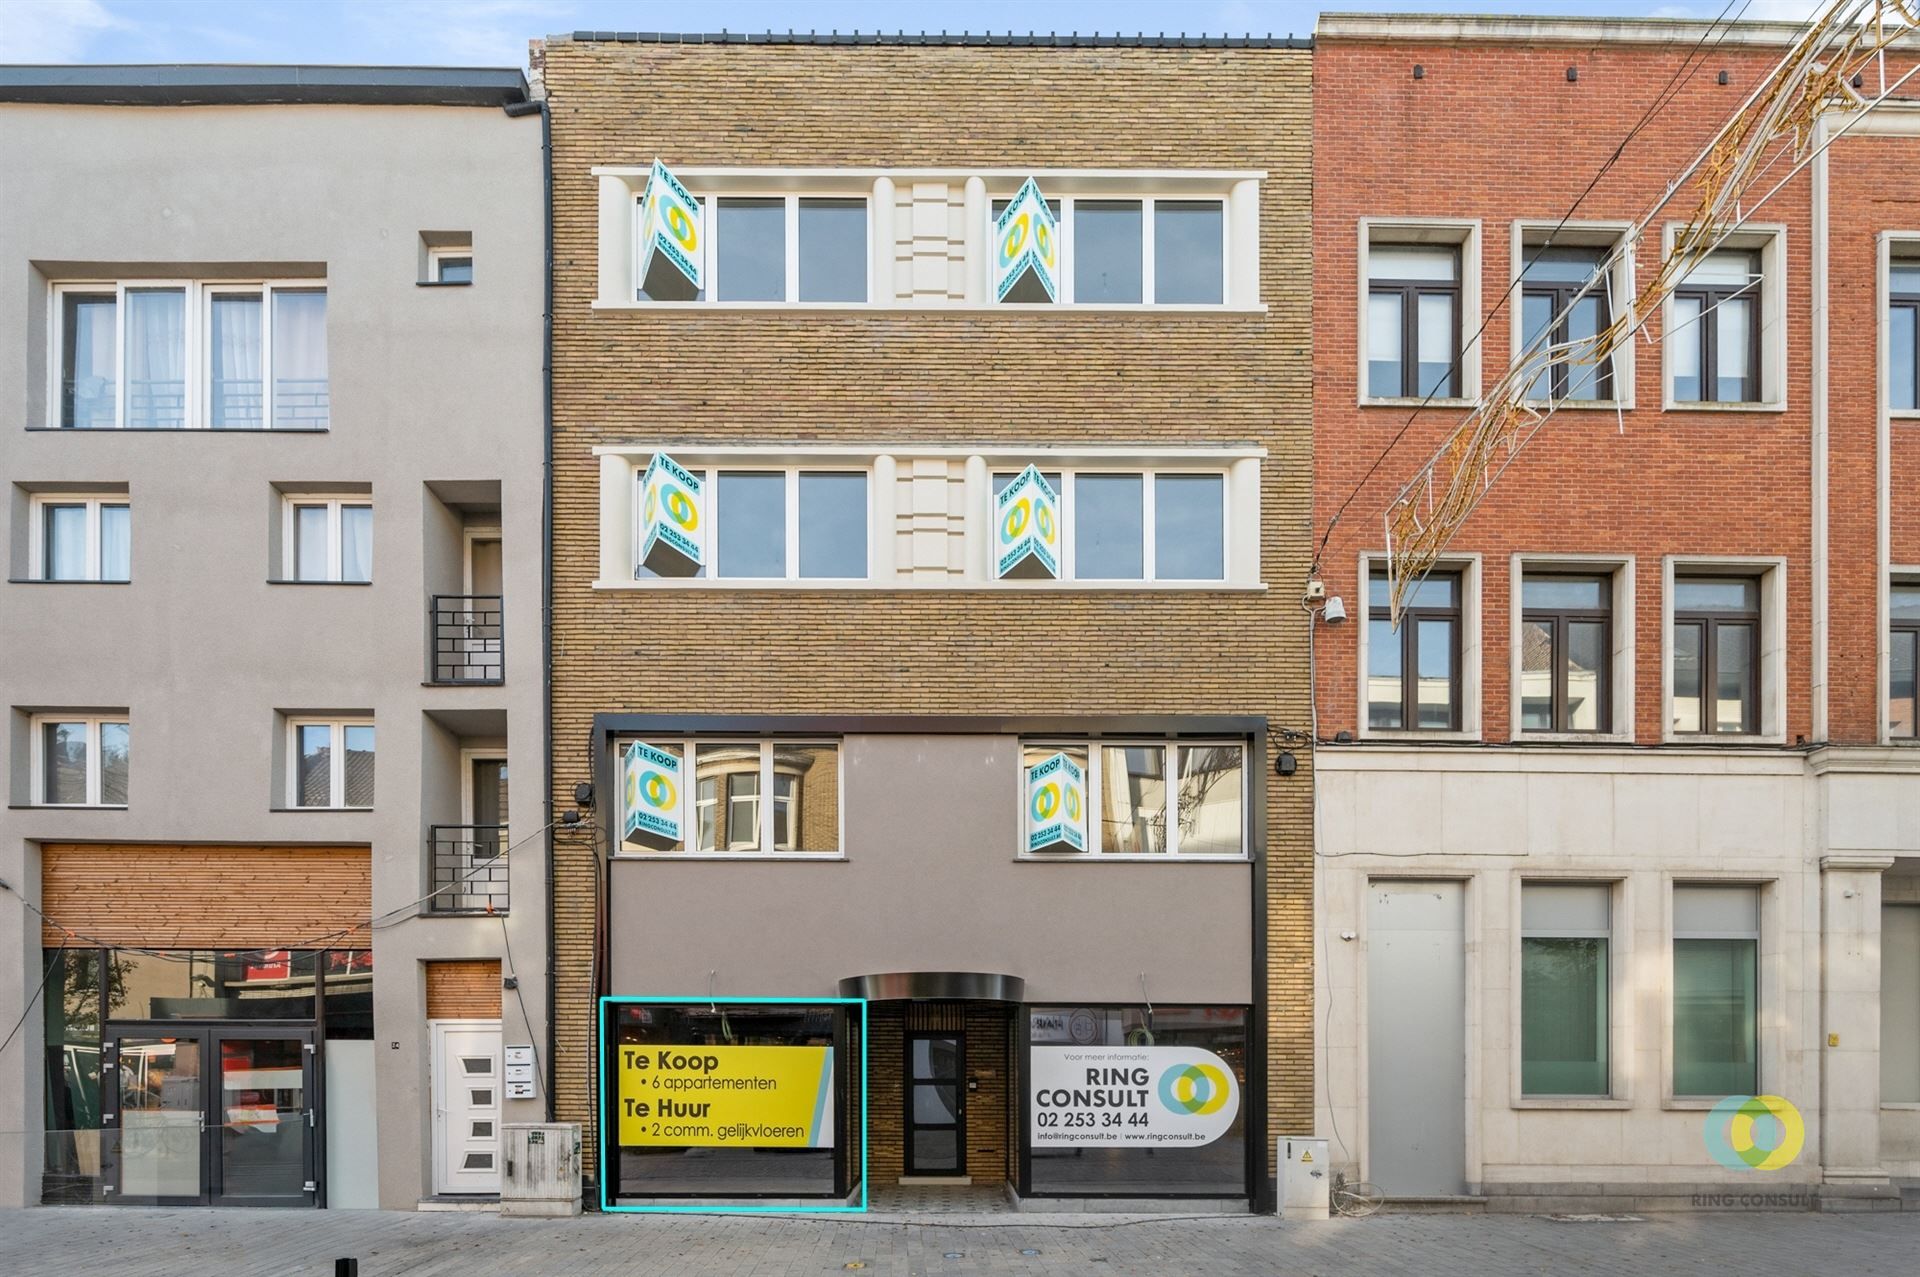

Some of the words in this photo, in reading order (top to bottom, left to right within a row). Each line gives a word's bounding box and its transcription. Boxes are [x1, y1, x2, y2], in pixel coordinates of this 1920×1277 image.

[658, 166, 669, 182] TE
[672, 181, 698, 212] KOOP
[999, 218, 1007, 229] TE
[1007, 184, 1030, 217] KOOP
[660, 456, 670, 470] TE
[672, 466, 699, 490] KOOP
[1000, 492, 1008, 504] TE
[1009, 471, 1031, 496] KOOP
[659, 523, 668, 533] 02
[669, 528, 681, 542] 253
[682, 536, 690, 547] 34
[690, 544, 699, 553] 44
[638, 746, 648, 758] TE
[650, 751, 677, 768] KOOP
[1030, 769, 1038, 781] TE
[1039, 758, 1060, 776] KOOP
[638, 812, 647, 821] 02
[648, 815, 659, 825] 253
[661, 819, 668, 827] 34
[669, 822, 677, 830] 44
[1030, 833, 1038, 841] 02
[1038, 830, 1047, 839] 253
[1047, 827, 1054, 836] 34
[1054, 824, 1061, 833] 44
[624, 1051, 650, 1070] Te
[658, 1051, 719, 1074] Koop
[1064, 1053, 1083, 1061] Voor
[1107, 1053, 1149, 1061] informatie:
[652, 1075, 660, 1089] 6
[664, 1076, 777, 1092] appartementen
[1086, 1068, 1149, 1086] RING
[1036, 1089, 1149, 1108] CONSULT
[624, 1099, 650, 1117] Te
[658, 1099, 711, 1118] Huur
[1037, 1112, 1058, 1127] 02
[1064, 1112, 1096, 1127] 253
[1101, 1112, 1122, 1127] 34
[1128, 1112, 1149, 1127] 44
[652, 1123, 660, 1137] 2
[664, 1125, 713, 1137] comm.
[717, 1123, 804, 1140] gelijkvloeren
[1037, 1132, 1117, 1141] info@ringconsult.be
[1125, 1132, 1206, 1141] www.ringconsult.be
